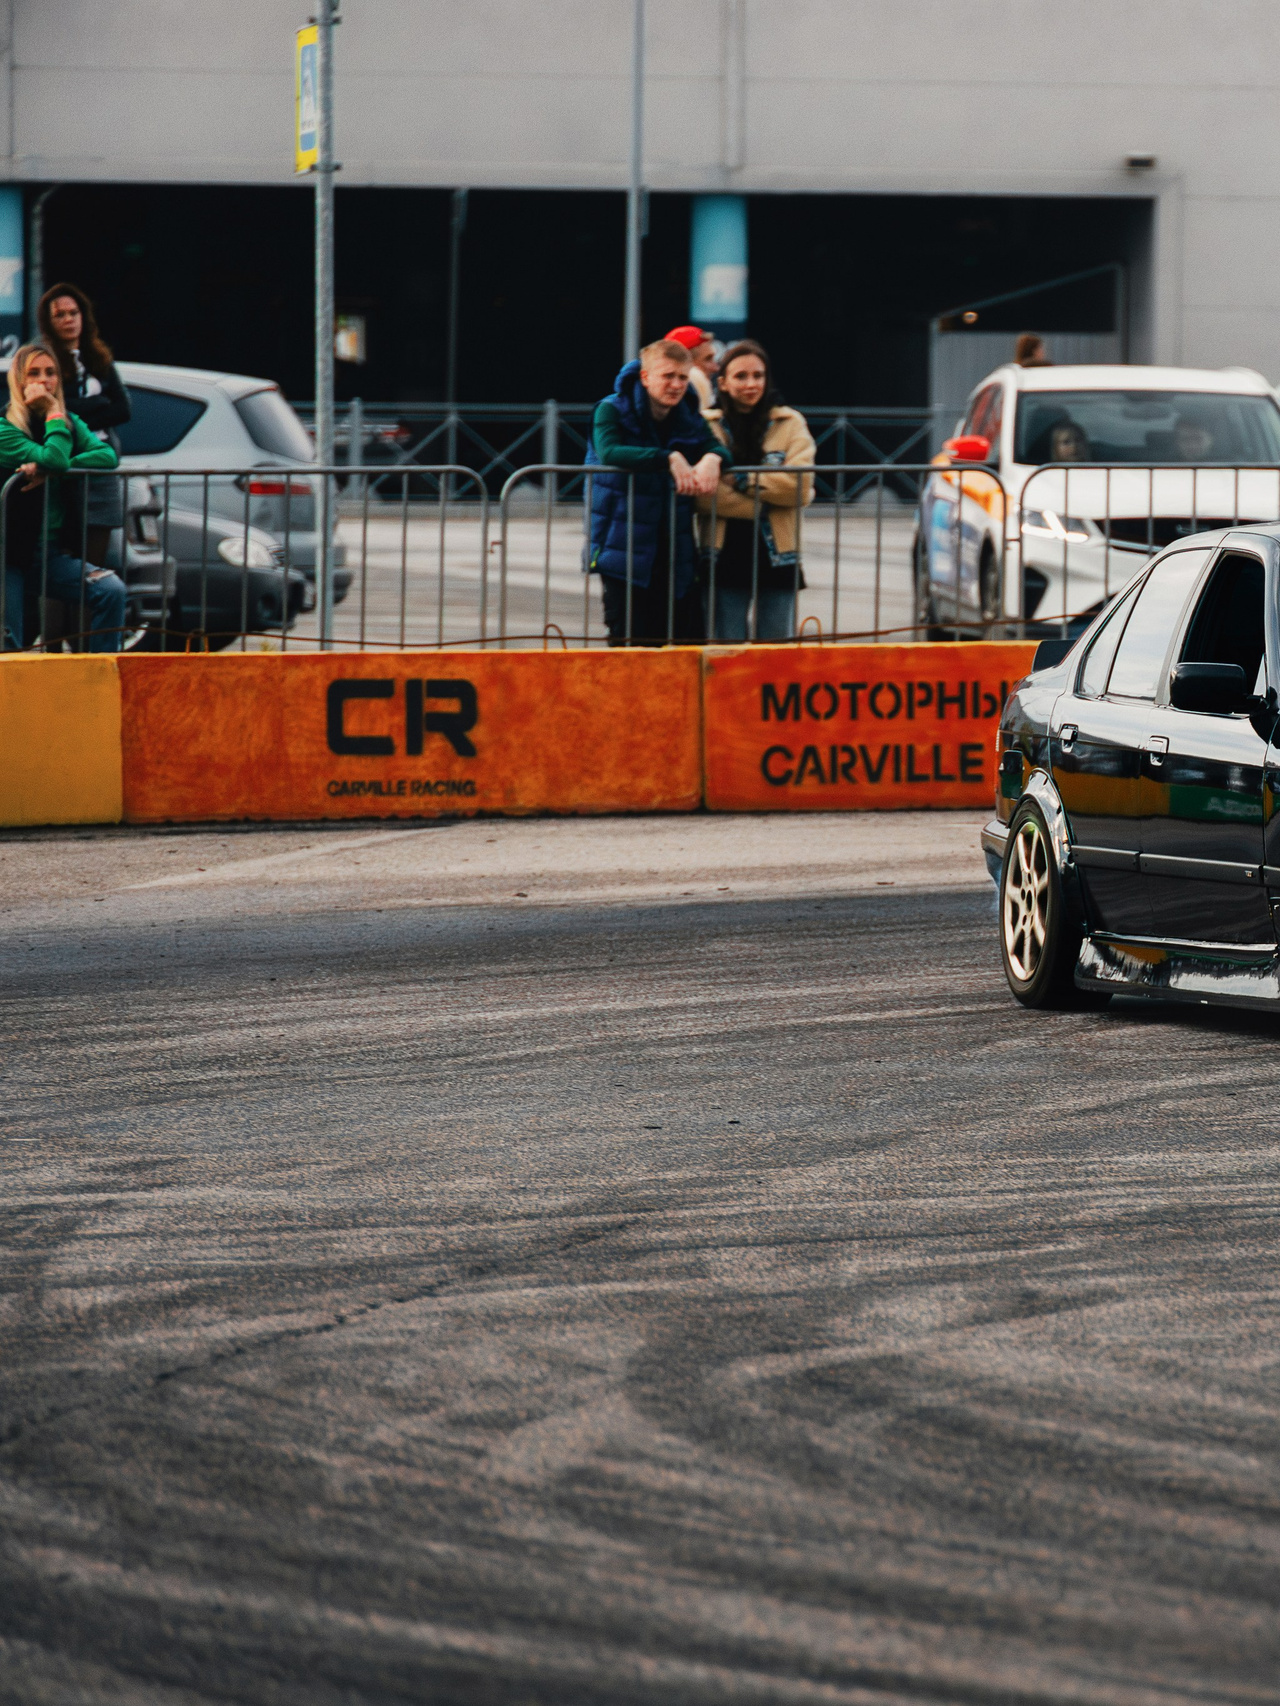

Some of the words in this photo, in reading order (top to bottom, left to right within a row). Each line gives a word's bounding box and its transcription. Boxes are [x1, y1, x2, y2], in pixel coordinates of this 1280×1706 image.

[327, 678, 479, 758] CR
[761, 681, 1019, 721] МОТОРНЫ
[761, 743, 984, 786] CARVILLE
[327, 779, 406, 796] CARVILLE
[411, 780, 477, 796] RACING
